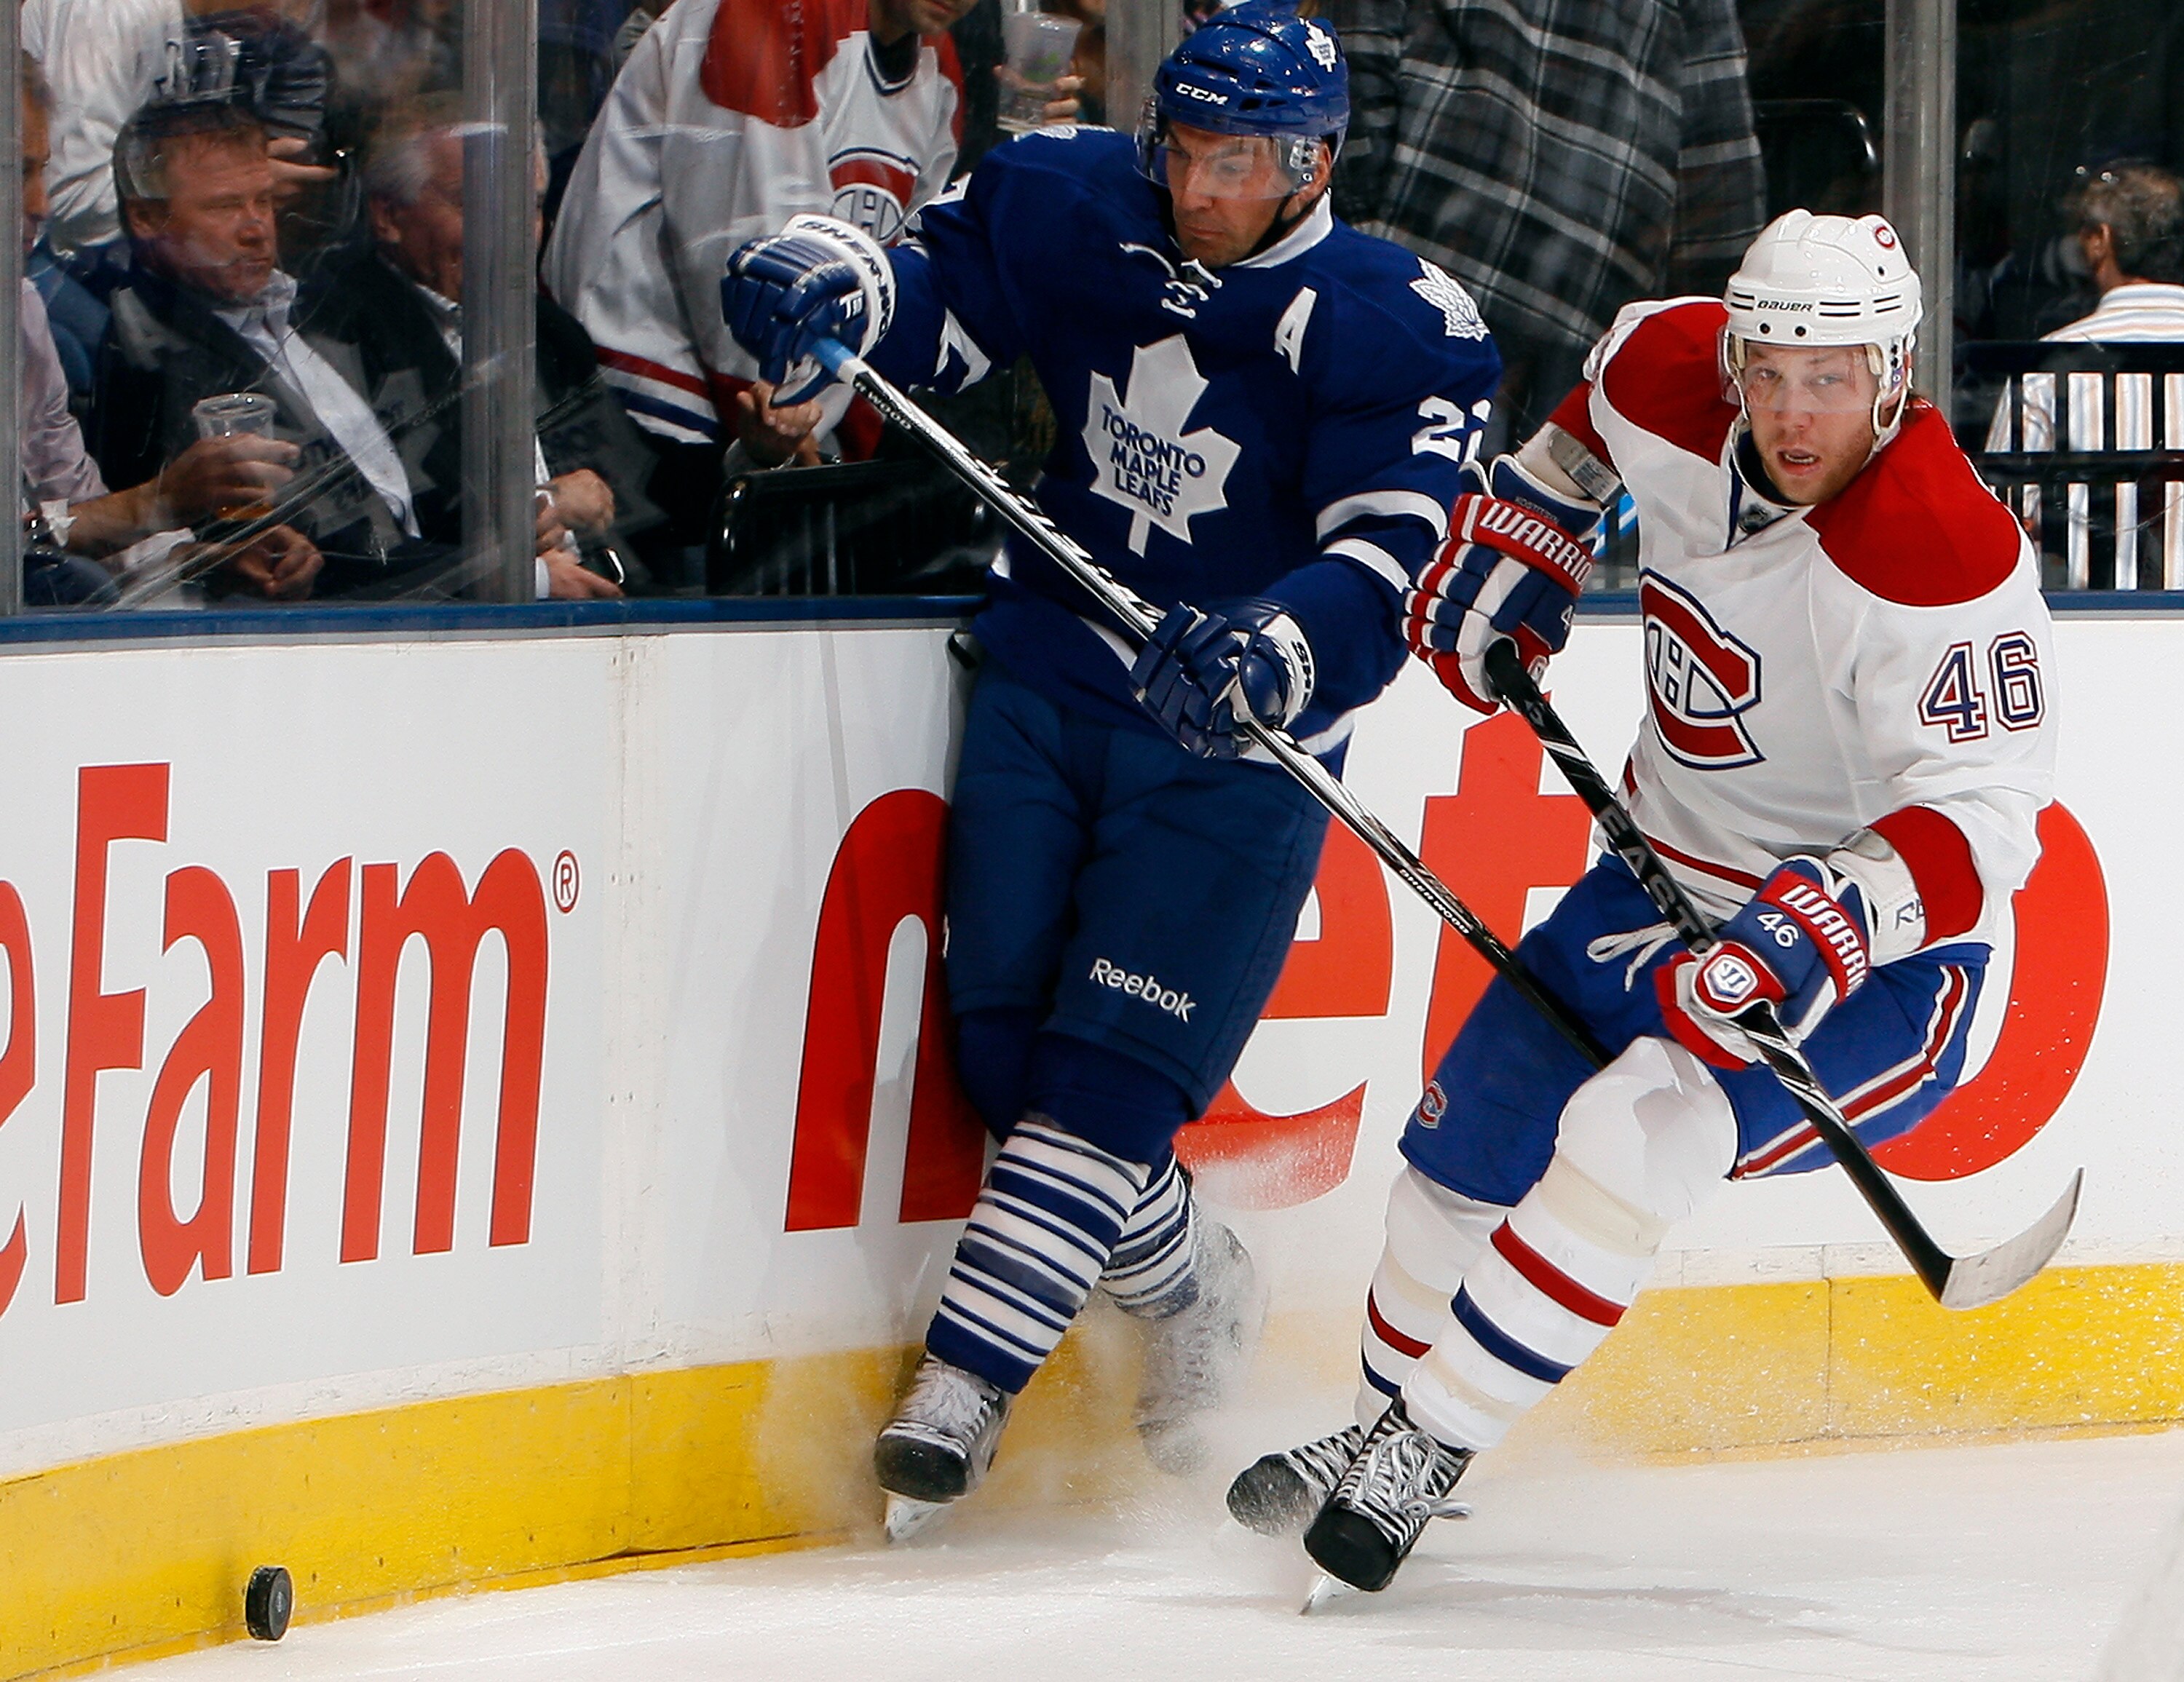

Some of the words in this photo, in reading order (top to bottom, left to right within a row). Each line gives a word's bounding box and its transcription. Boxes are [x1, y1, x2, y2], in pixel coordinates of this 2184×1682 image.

[1176, 82, 1229, 106] CCM
[1273, 285, 1318, 376] A
[1757, 300, 1813, 313] BAUER
[1102, 403, 1206, 478] TORONTO
[1109, 440, 1182, 497] MAPLE
[1114, 467, 1174, 517] LEAFS
[1917, 630, 2047, 745] 46
[1757, 912, 1800, 949] 46
[1089, 957, 1197, 1024] Reebok
